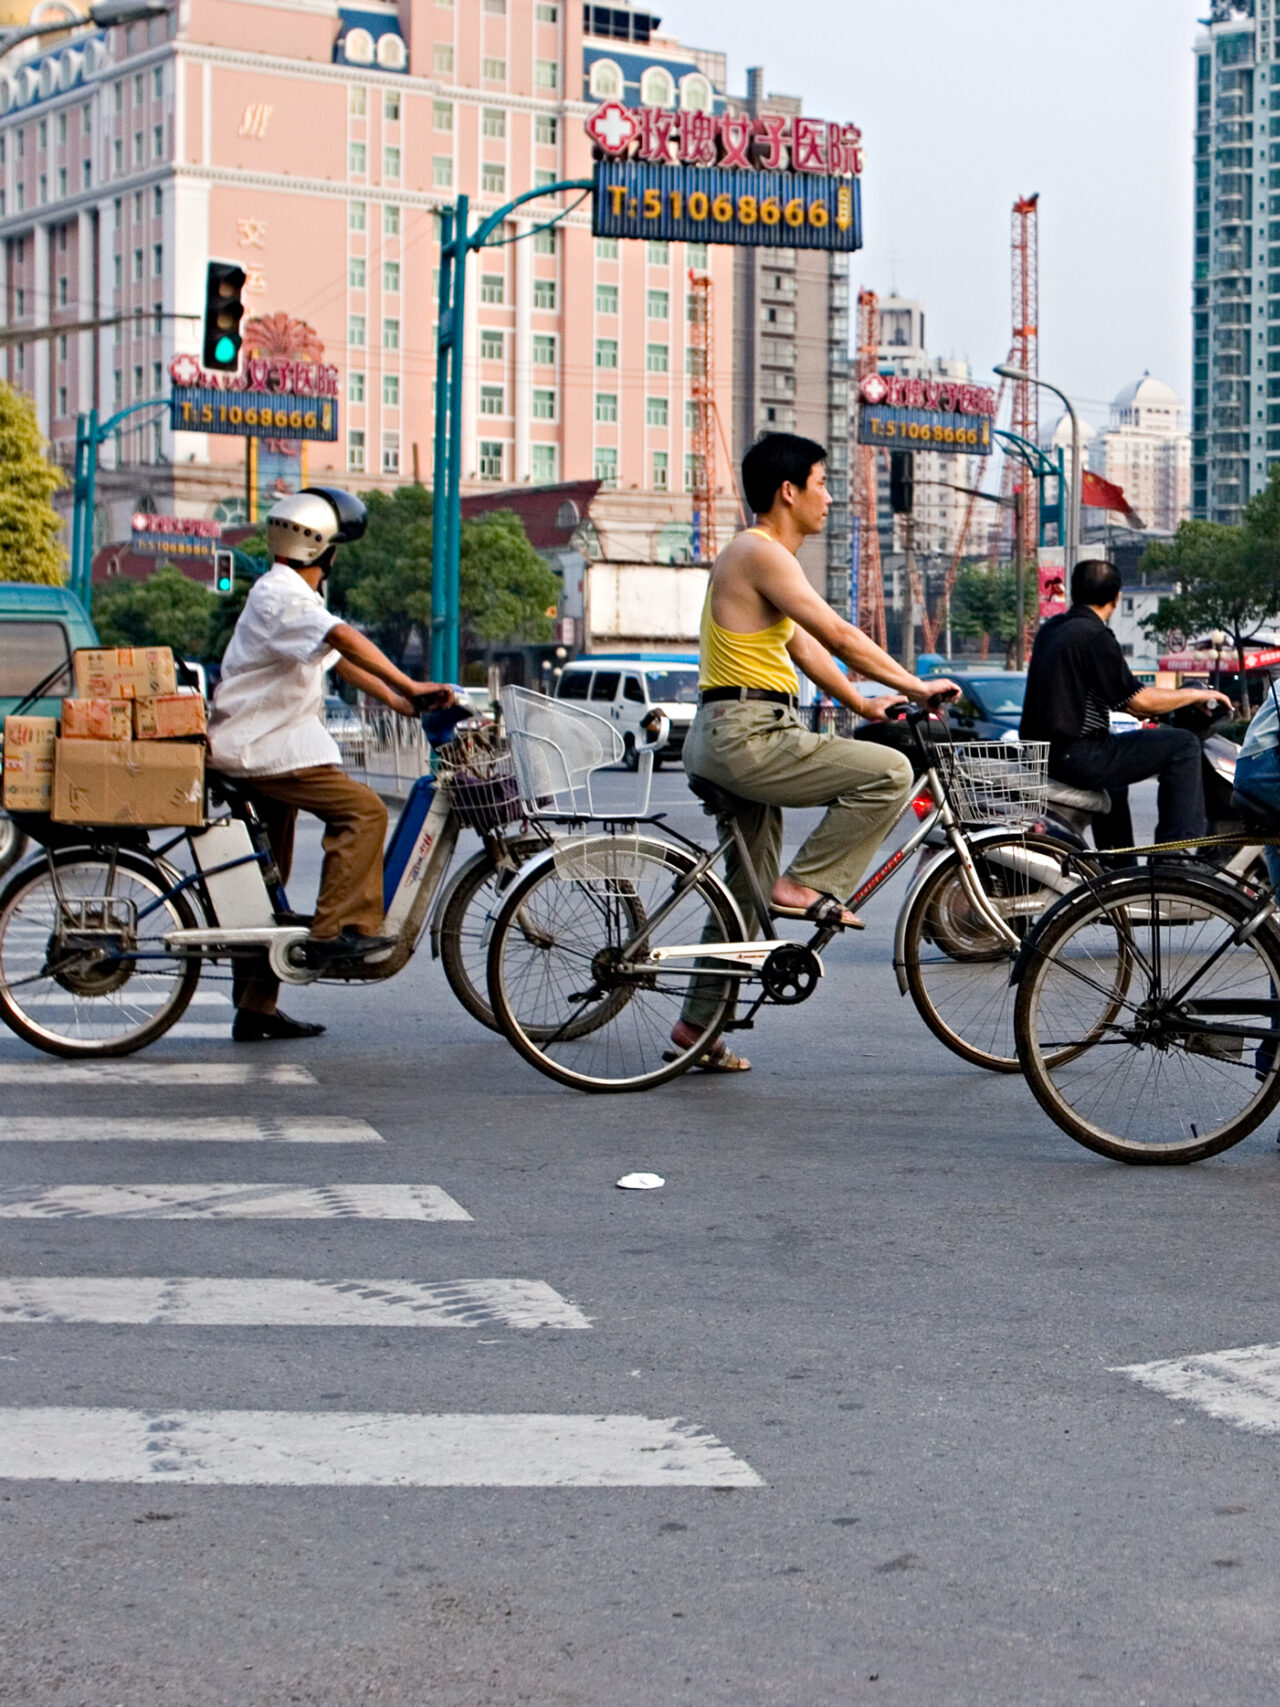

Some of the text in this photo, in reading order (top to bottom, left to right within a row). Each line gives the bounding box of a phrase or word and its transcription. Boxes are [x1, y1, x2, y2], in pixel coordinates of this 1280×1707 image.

[637, 106, 864, 176] 玫瑰女子医院
[607, 186, 830, 229] T:51068666
[180, 401, 317, 430] T:51068666
[870, 418, 979, 445] T:51068666
